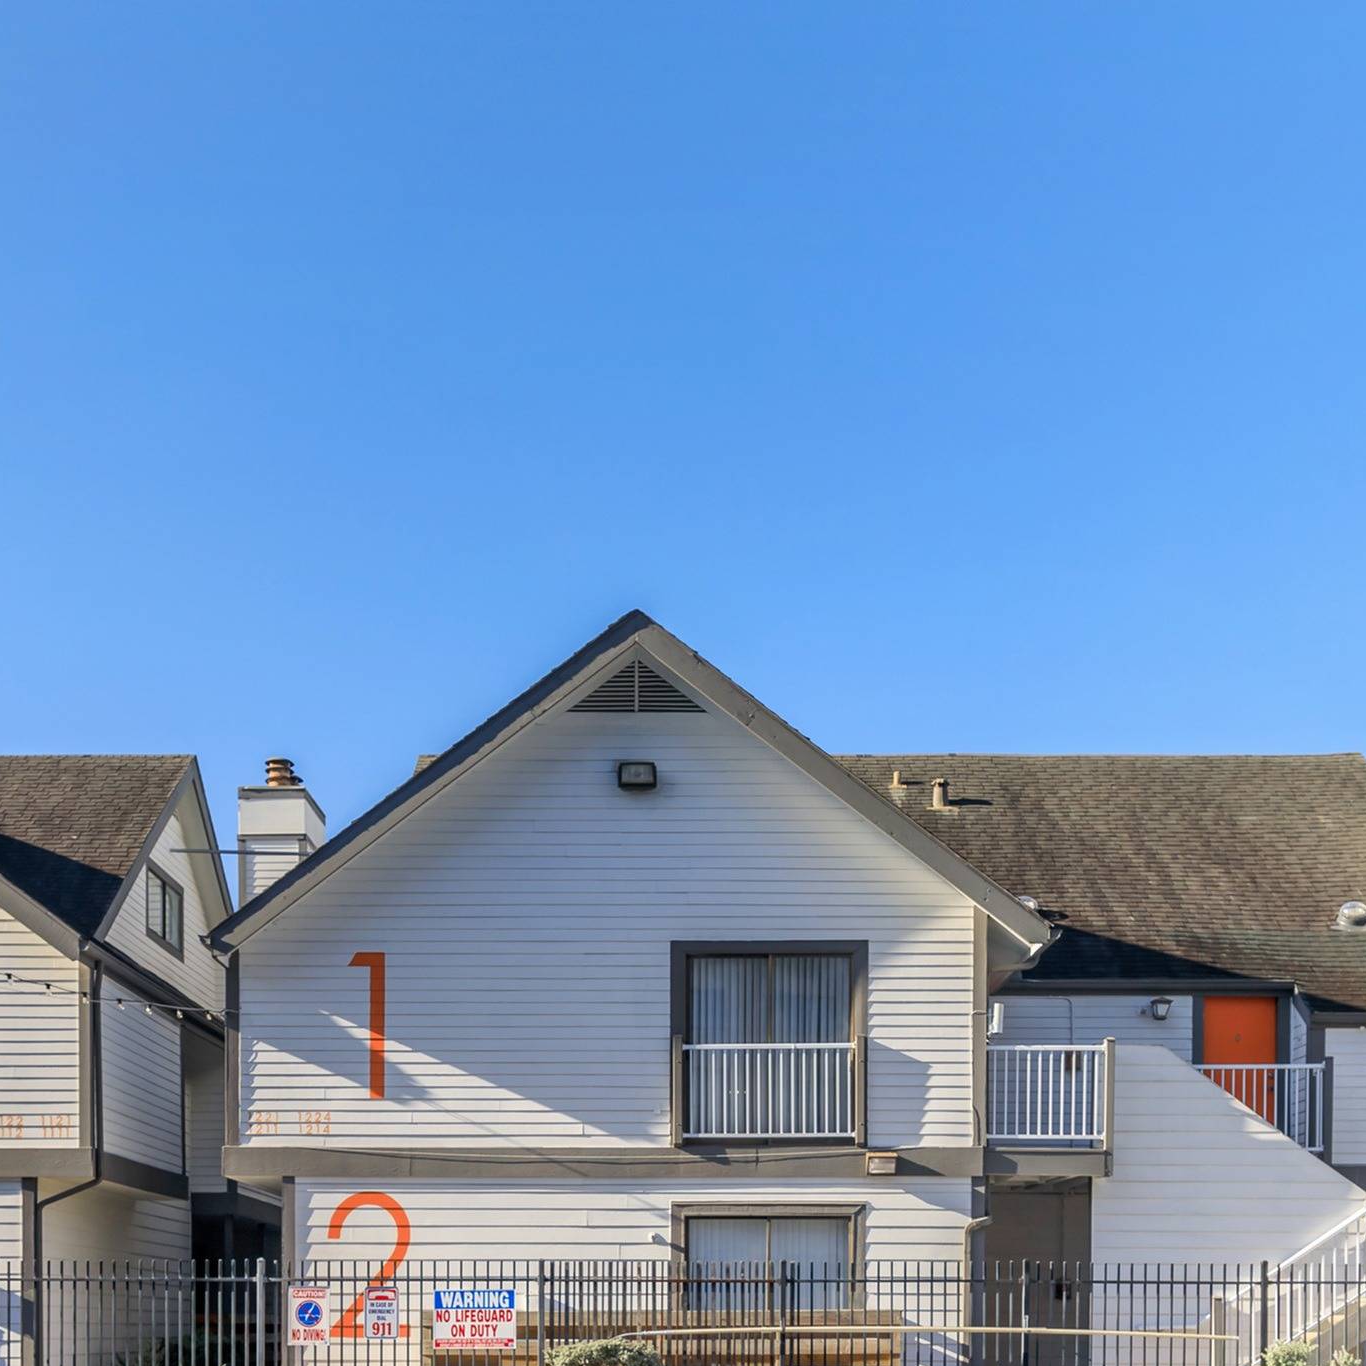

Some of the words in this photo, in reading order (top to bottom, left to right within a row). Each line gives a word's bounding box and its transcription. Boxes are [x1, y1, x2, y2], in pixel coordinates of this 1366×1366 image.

[440, 1291, 510, 1308] WARNING
[436, 1310, 450, 1322] NO
[456, 1310, 513, 1322] LIFEGUARD
[292, 1329, 300, 1341] NO
[372, 1322, 392, 1336] 911
[451, 1325, 466, 1337] ON
[470, 1325, 498, 1337] DUTY
